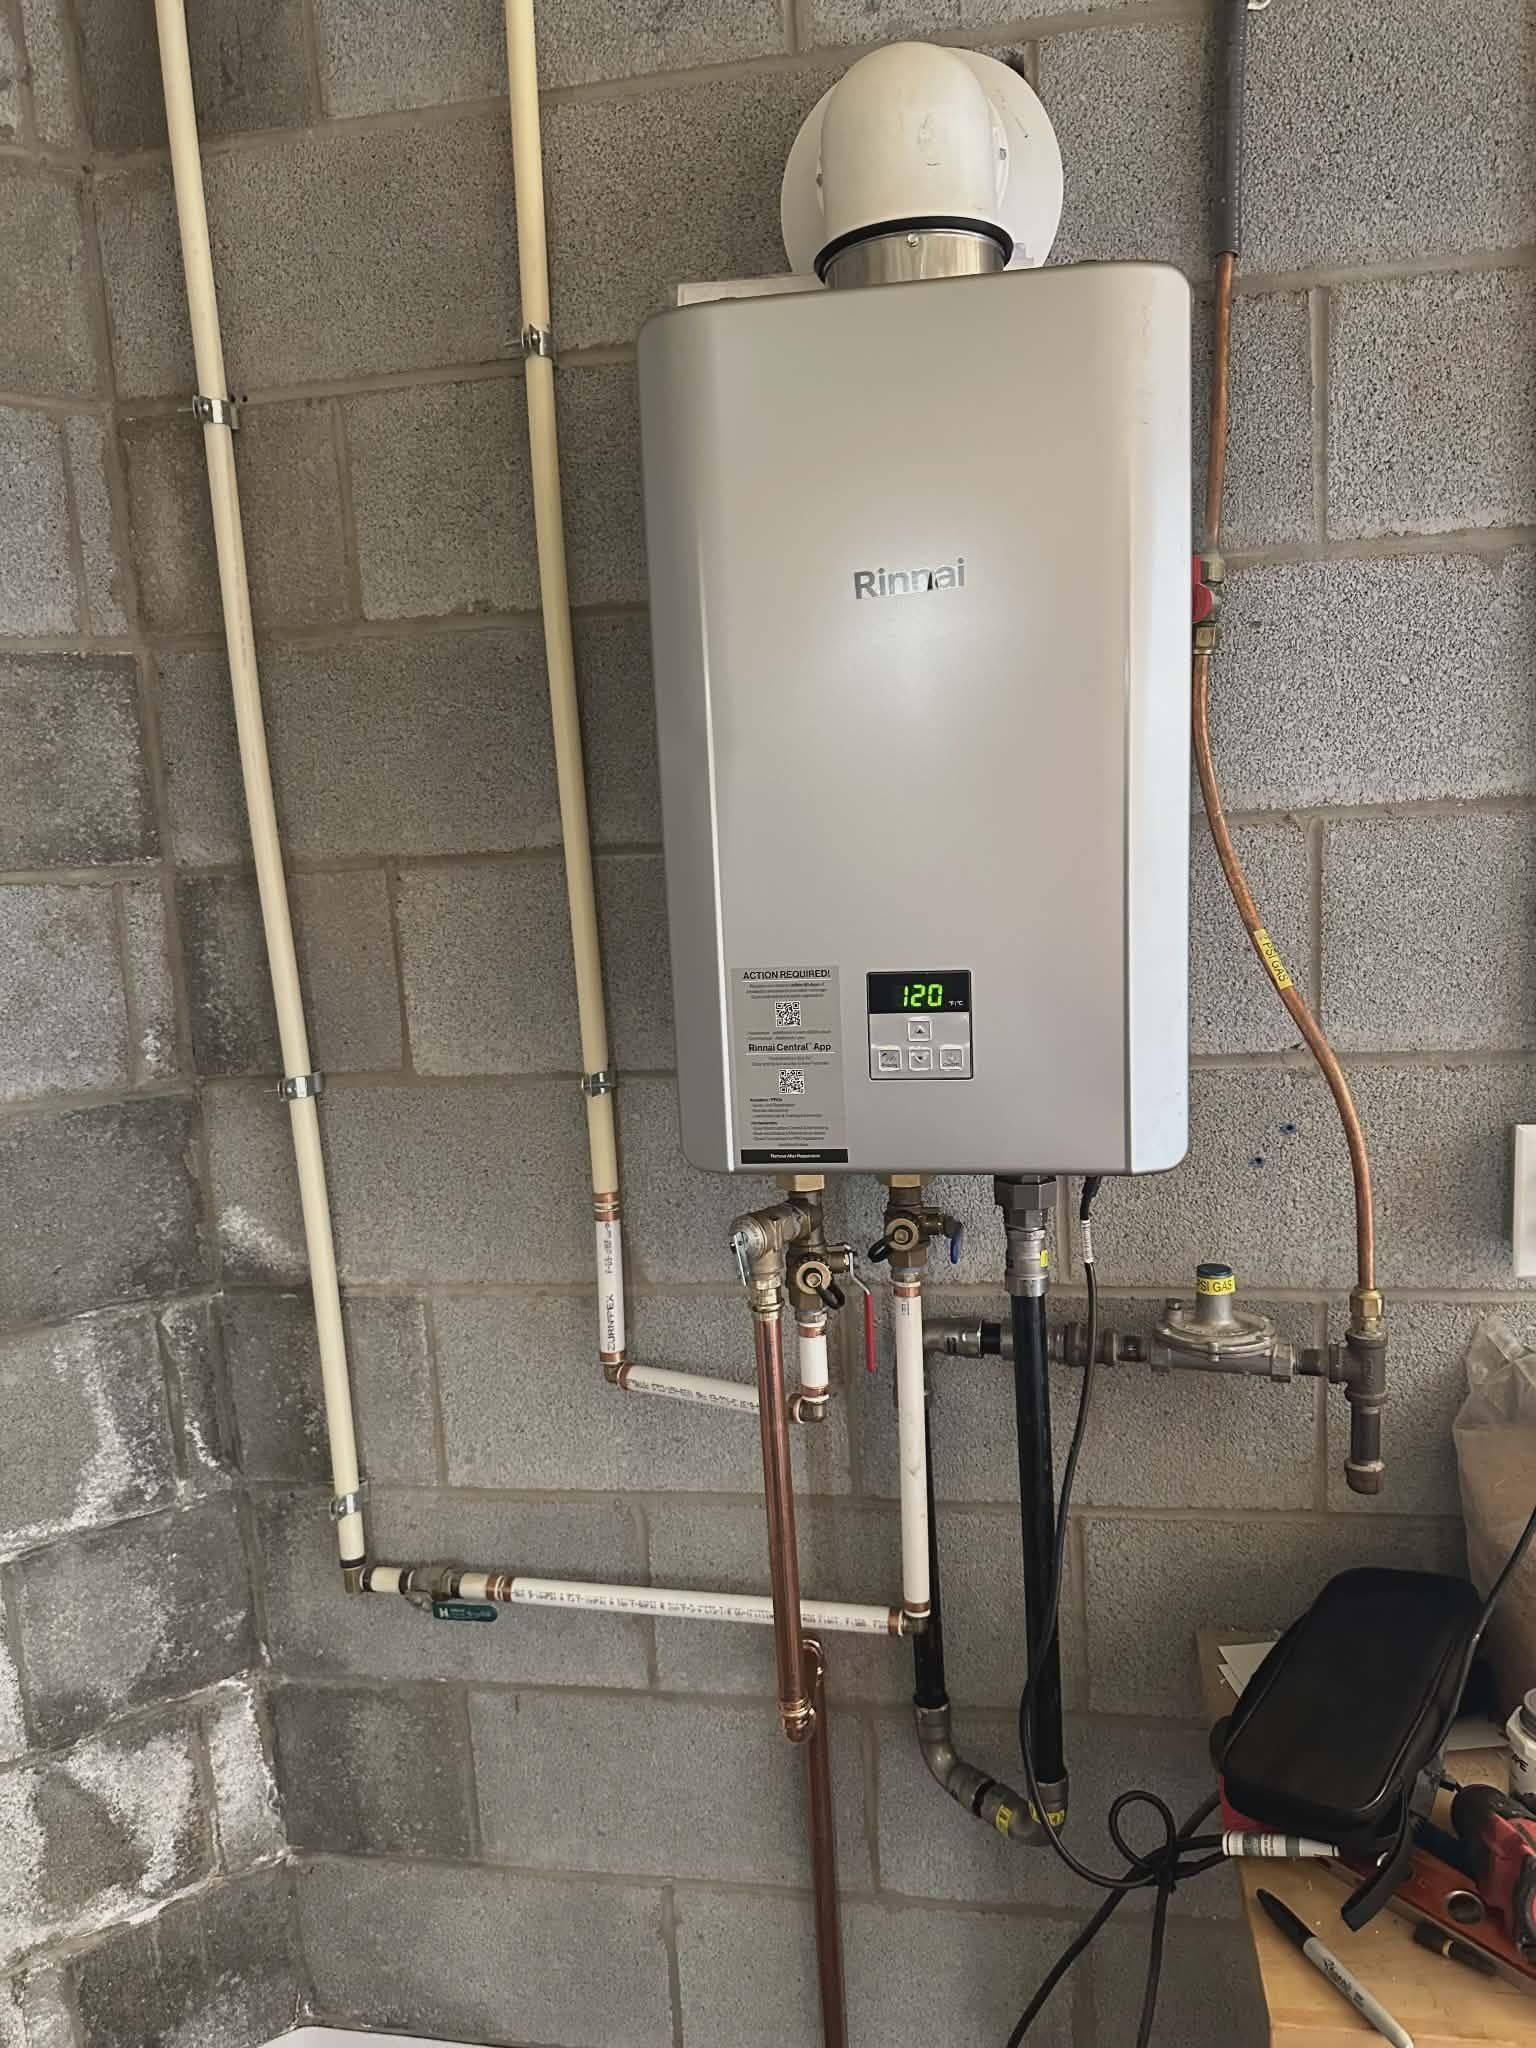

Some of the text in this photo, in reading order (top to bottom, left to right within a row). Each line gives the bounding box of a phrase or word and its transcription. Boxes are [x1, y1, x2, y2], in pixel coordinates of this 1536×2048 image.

[854, 557, 965, 600] Rinnai
[743, 969, 831, 980] ACTION REQUIRED!
[1272, 960, 1289, 982] GAS
[903, 983, 943, 1007] 120
[748, 1043, 776, 1052] Rinnai
[813, 1042, 831, 1052] App
[1213, 1280, 1233, 1293] GAS
